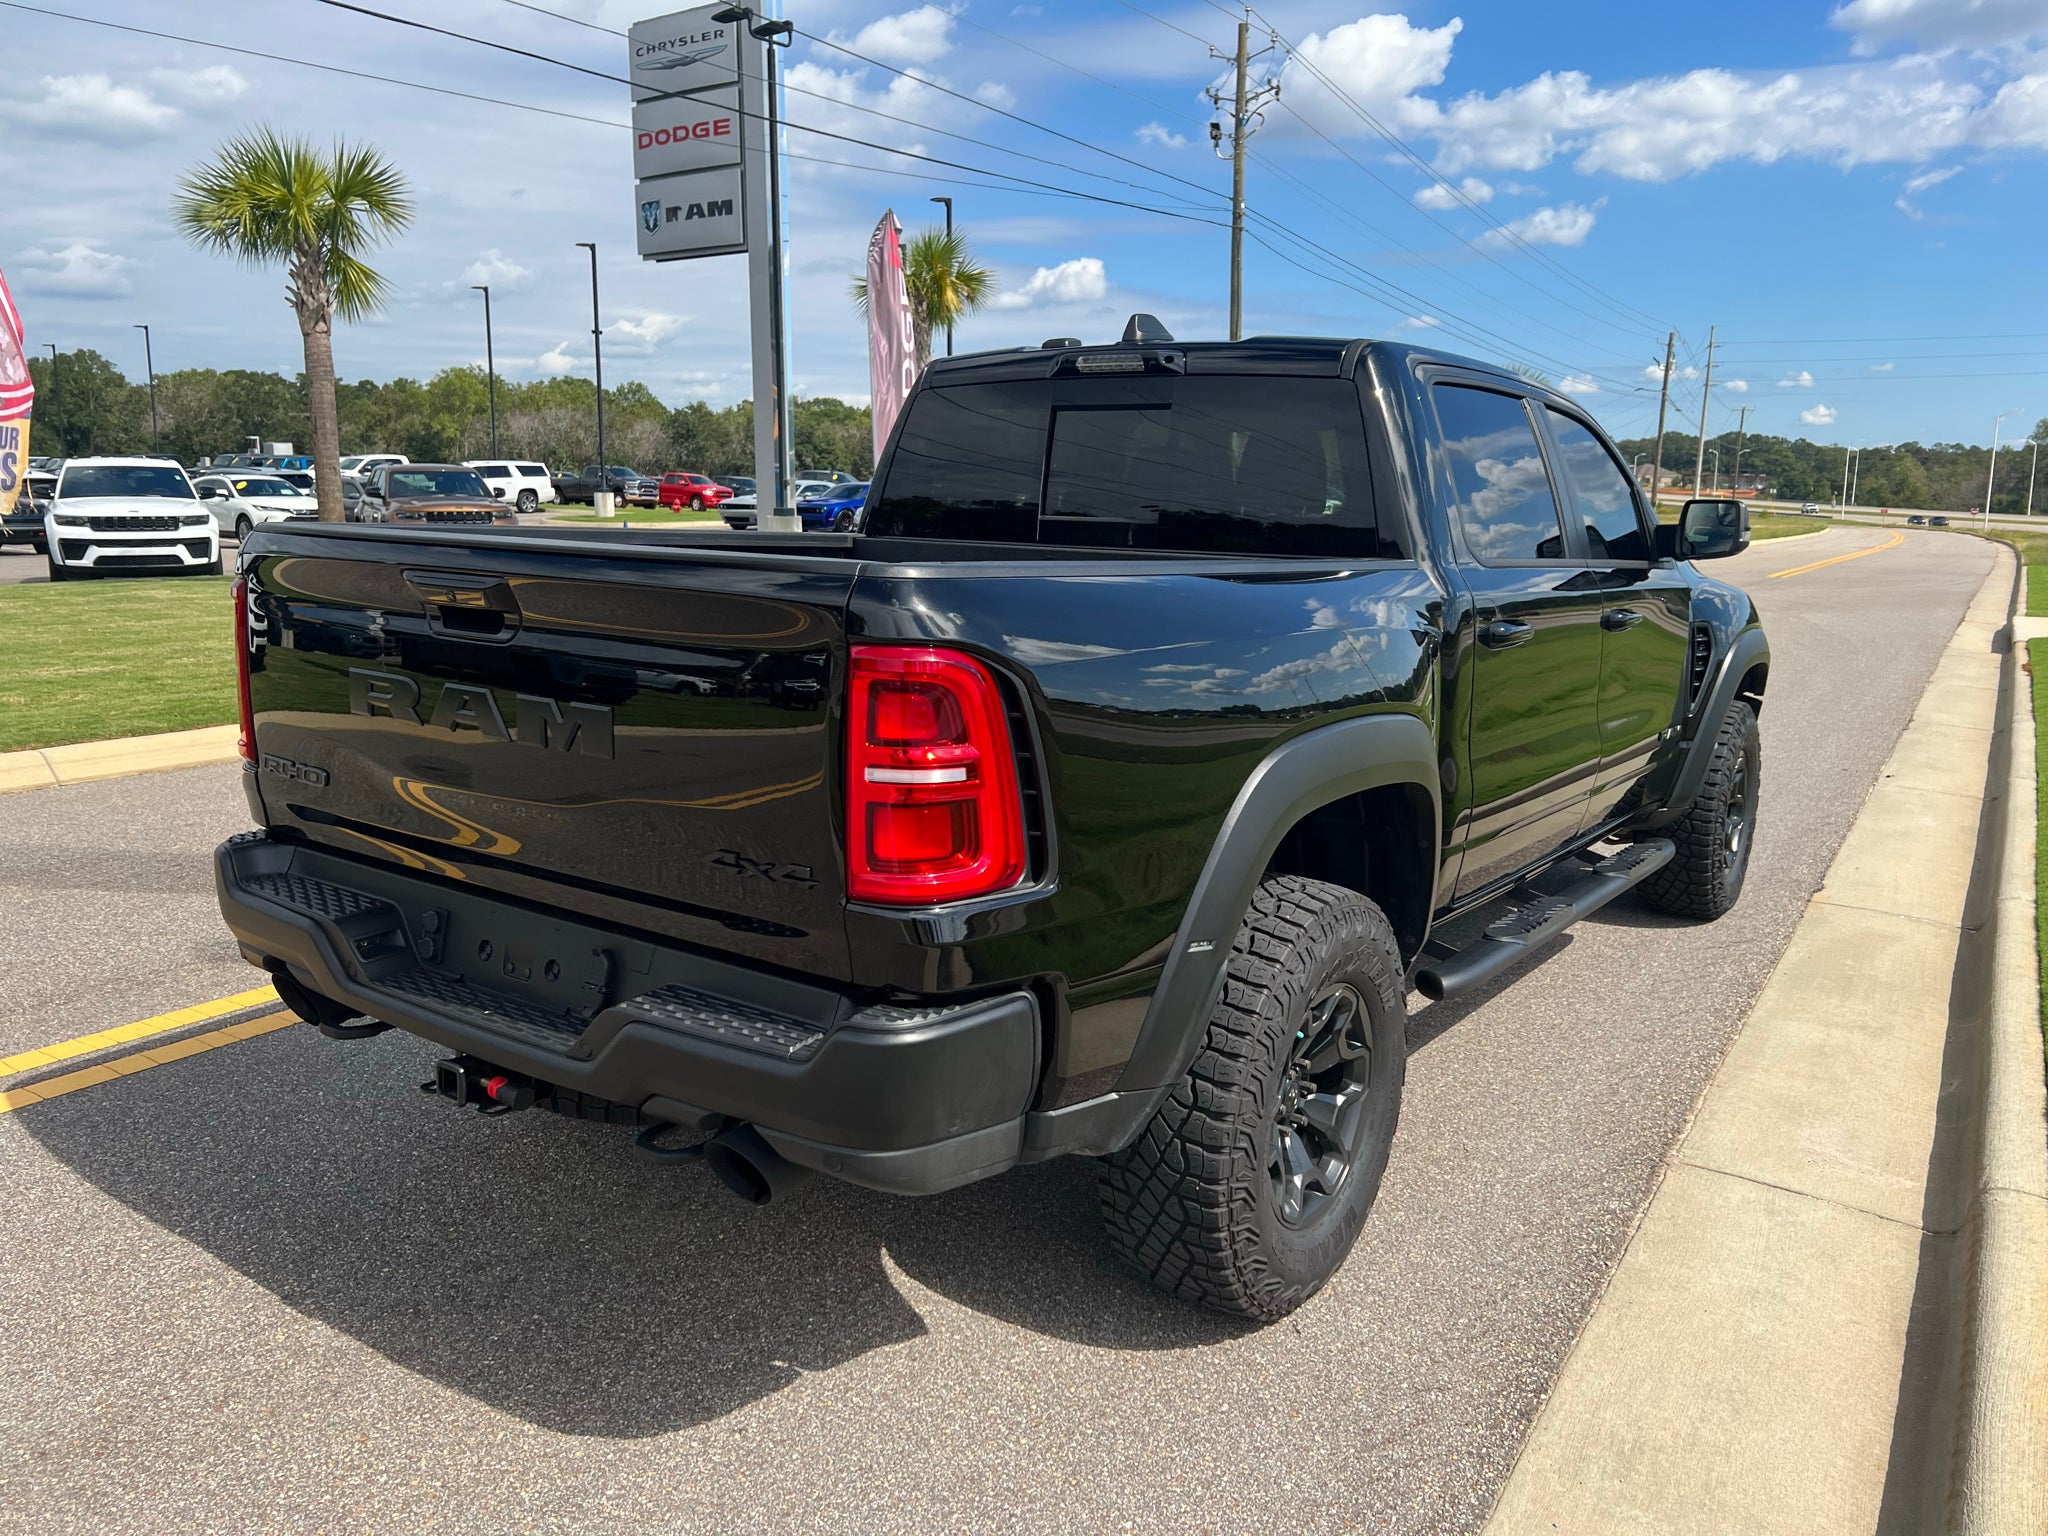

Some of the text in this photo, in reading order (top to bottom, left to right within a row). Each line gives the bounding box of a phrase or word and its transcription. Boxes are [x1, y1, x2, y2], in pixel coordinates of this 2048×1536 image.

[635, 29, 725, 57] CHRYSLER
[638, 118, 731, 150] DODGE
[665, 199, 734, 223] RAM
[348, 667, 615, 760] RAM
[263, 752, 331, 788] RHO
